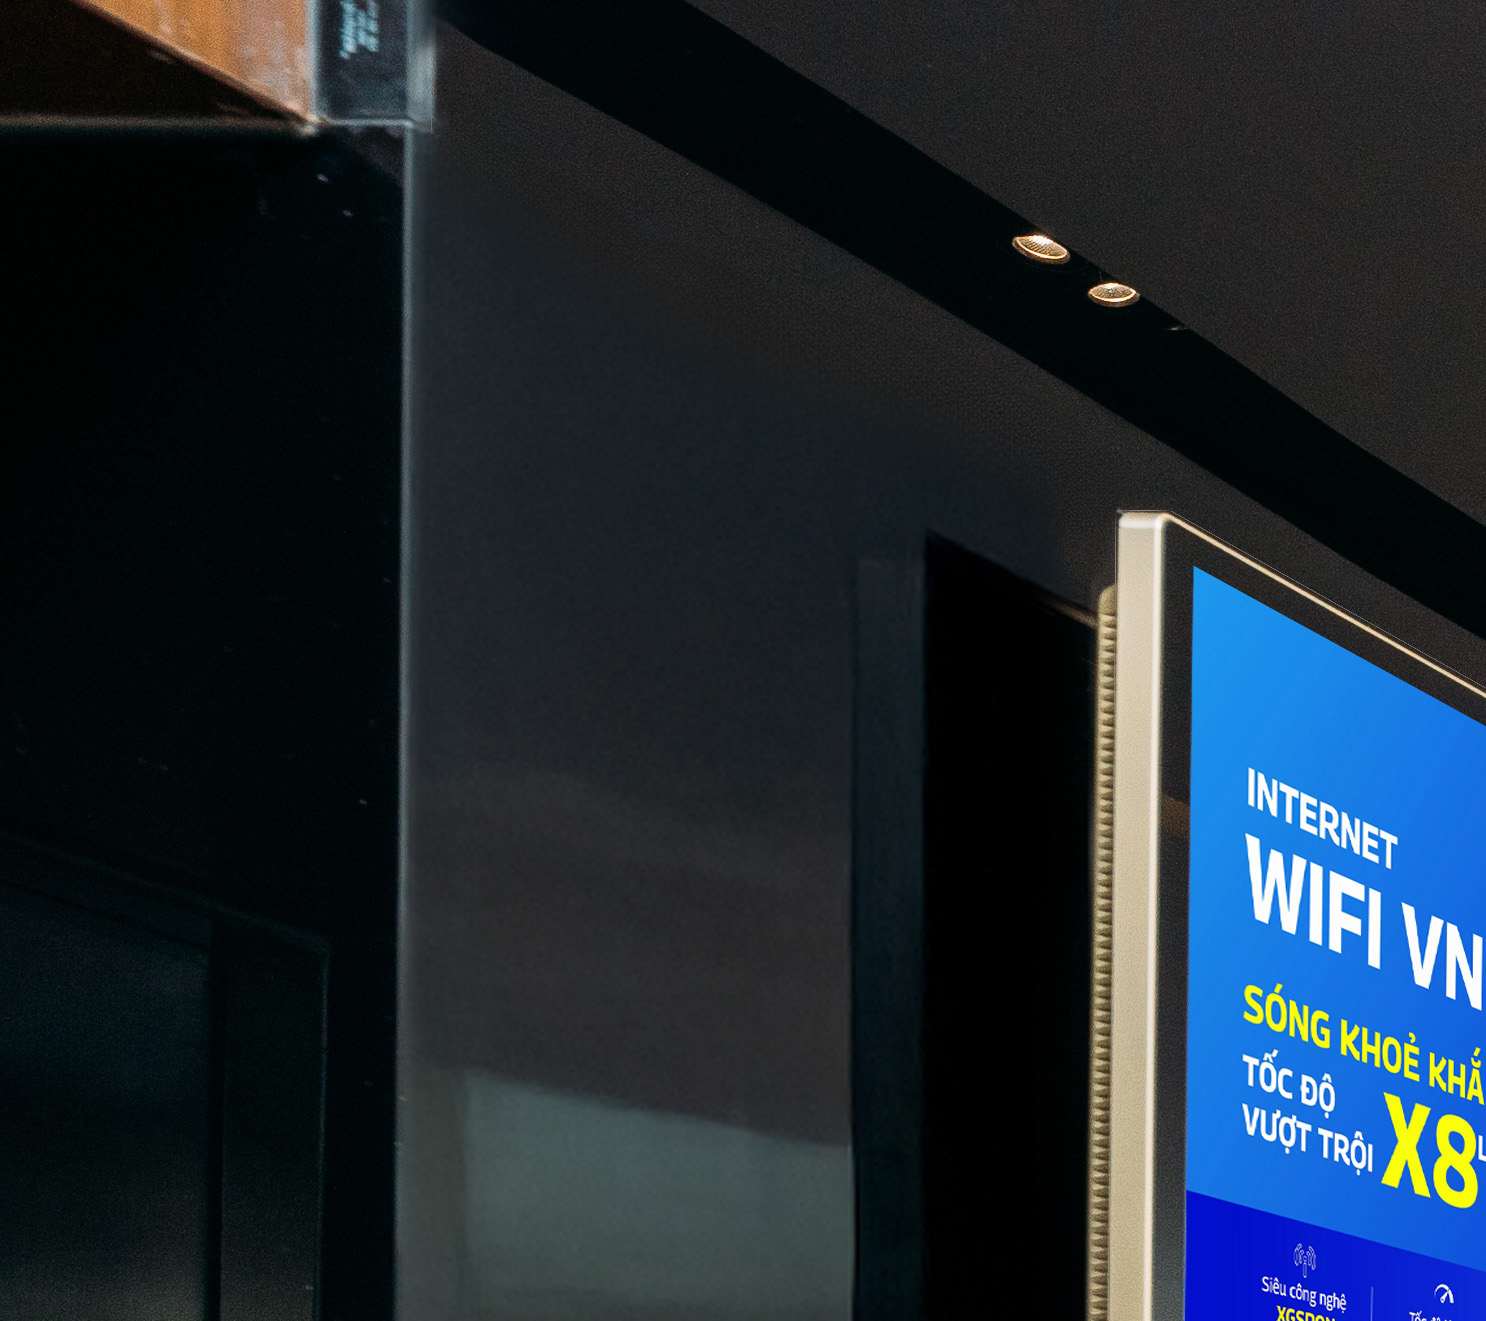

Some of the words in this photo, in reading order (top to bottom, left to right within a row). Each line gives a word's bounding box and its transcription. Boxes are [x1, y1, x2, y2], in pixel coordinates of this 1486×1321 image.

[1248, 767, 1398, 869] INTERNET
[1245, 833, 1381, 970] WIFI
[1243, 983, 1331, 1049] SÓNG
[1340, 1032, 1420, 1082] KHOẺ
[1242, 1049, 1293, 1099] TỐC
[1300, 1073, 1336, 1118] ĐỘ
[1242, 1103, 1312, 1154] VƯỢT
[1318, 1130, 1373, 1176] TRỘI
[1381, 1092, 1479, 1209] X8
[1261, 1276, 1286, 1296] Siêu
[1289, 1283, 1317, 1307] công
[1319, 1294, 1347, 1313] nghệ
